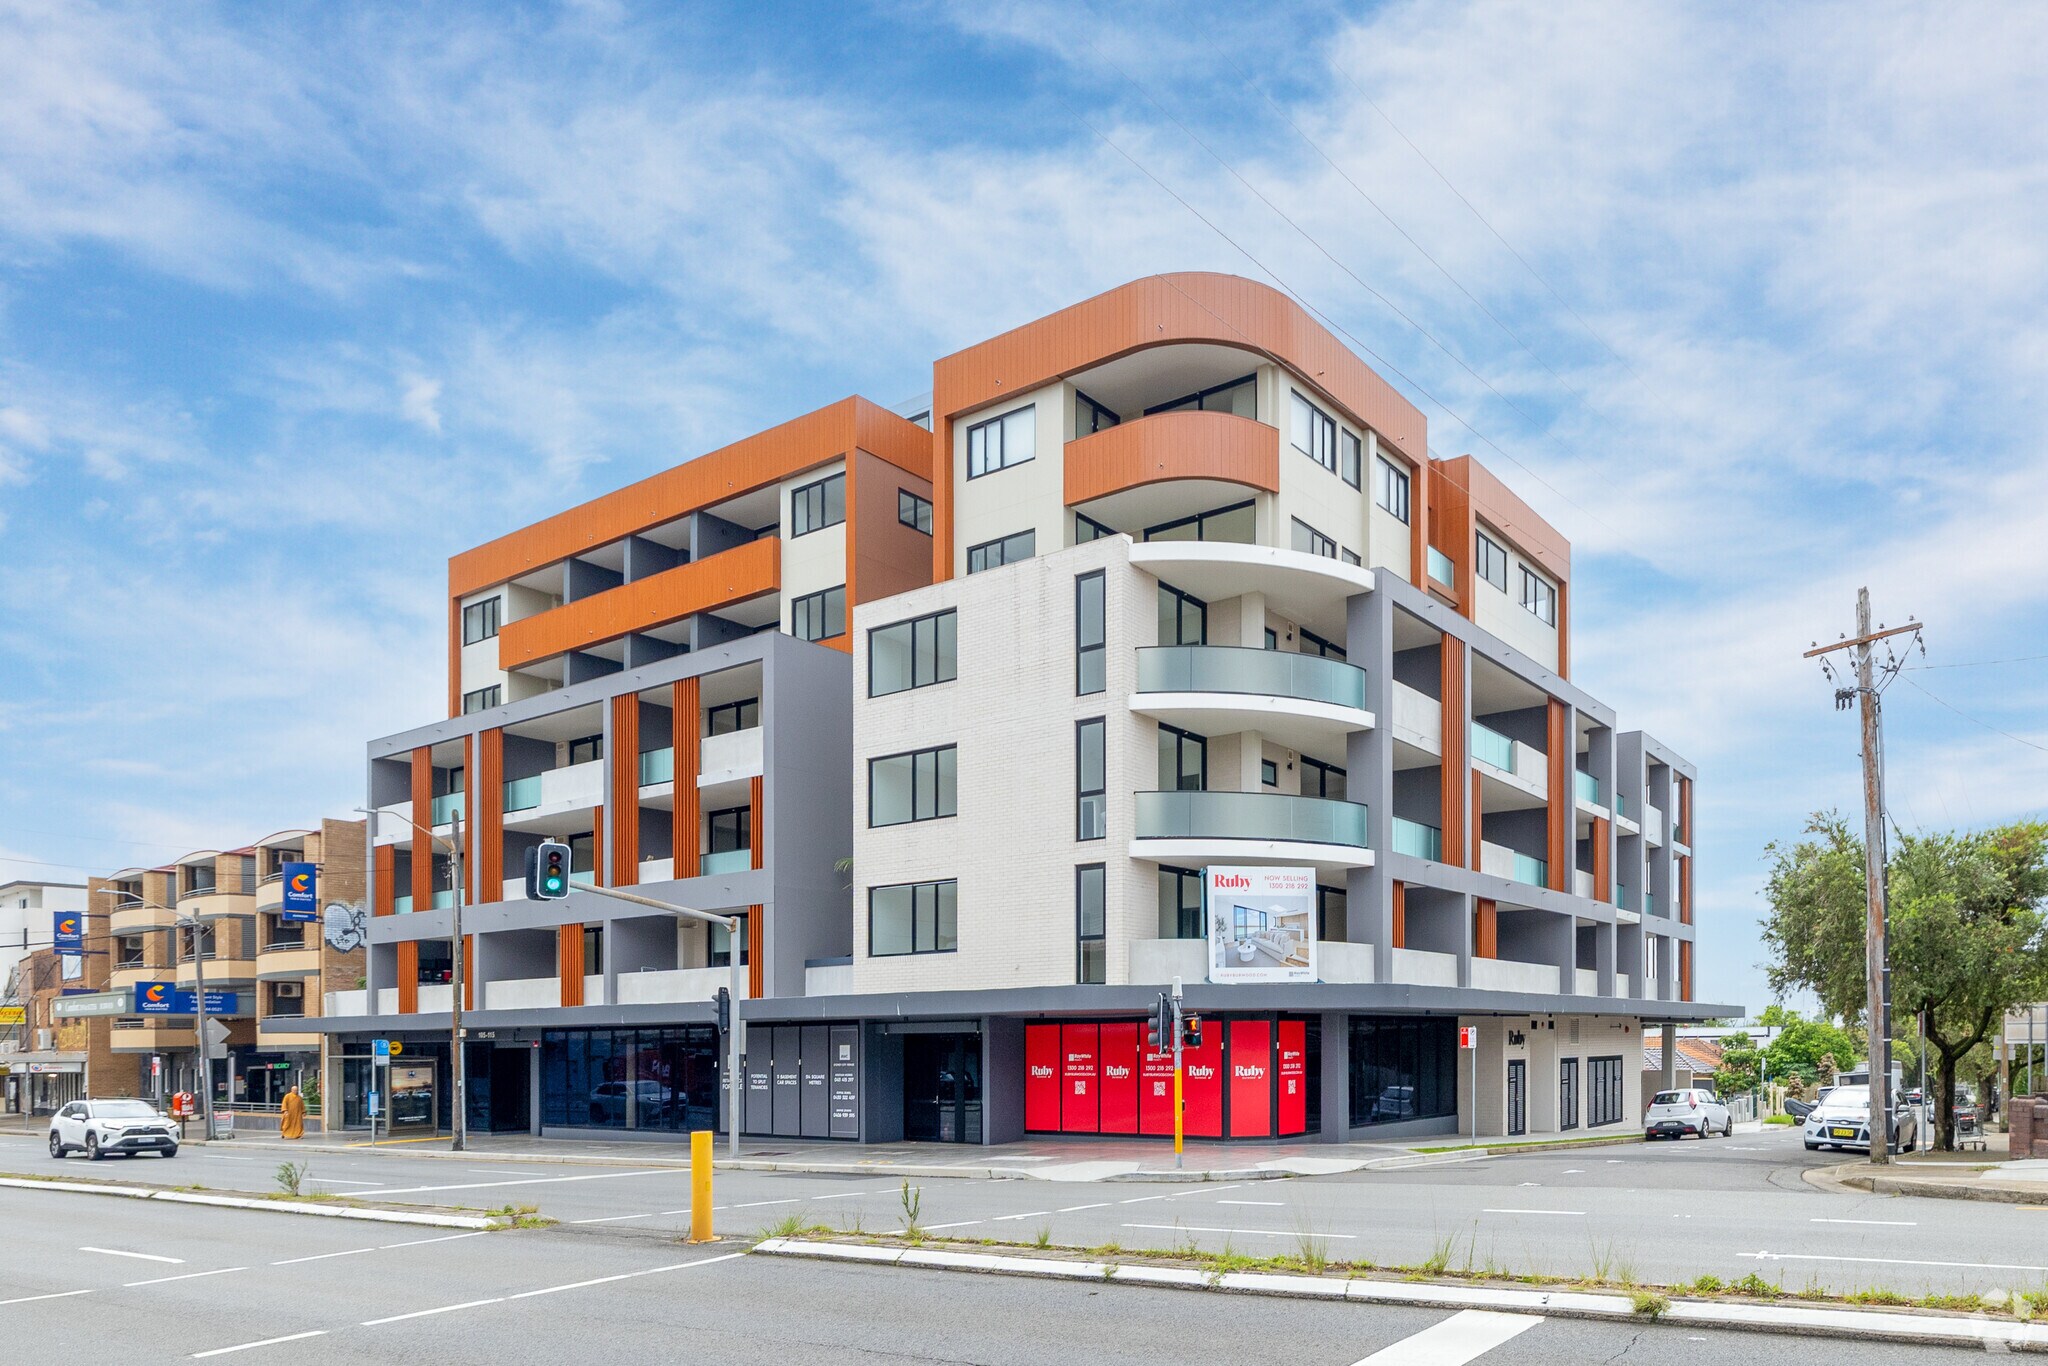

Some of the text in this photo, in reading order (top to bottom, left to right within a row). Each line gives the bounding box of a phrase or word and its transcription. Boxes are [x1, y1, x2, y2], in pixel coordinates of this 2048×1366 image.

[1214, 874, 1250, 892] Ruby
[288, 891, 313, 899] Comfort
[1508, 1030, 1526, 1049] Ruby
[1031, 1065, 1054, 1078] Ruby
[1106, 1065, 1130, 1079] Ruby
[1188, 1065, 1214, 1080] Ruby
[1235, 1065, 1265, 1080] Ruby
